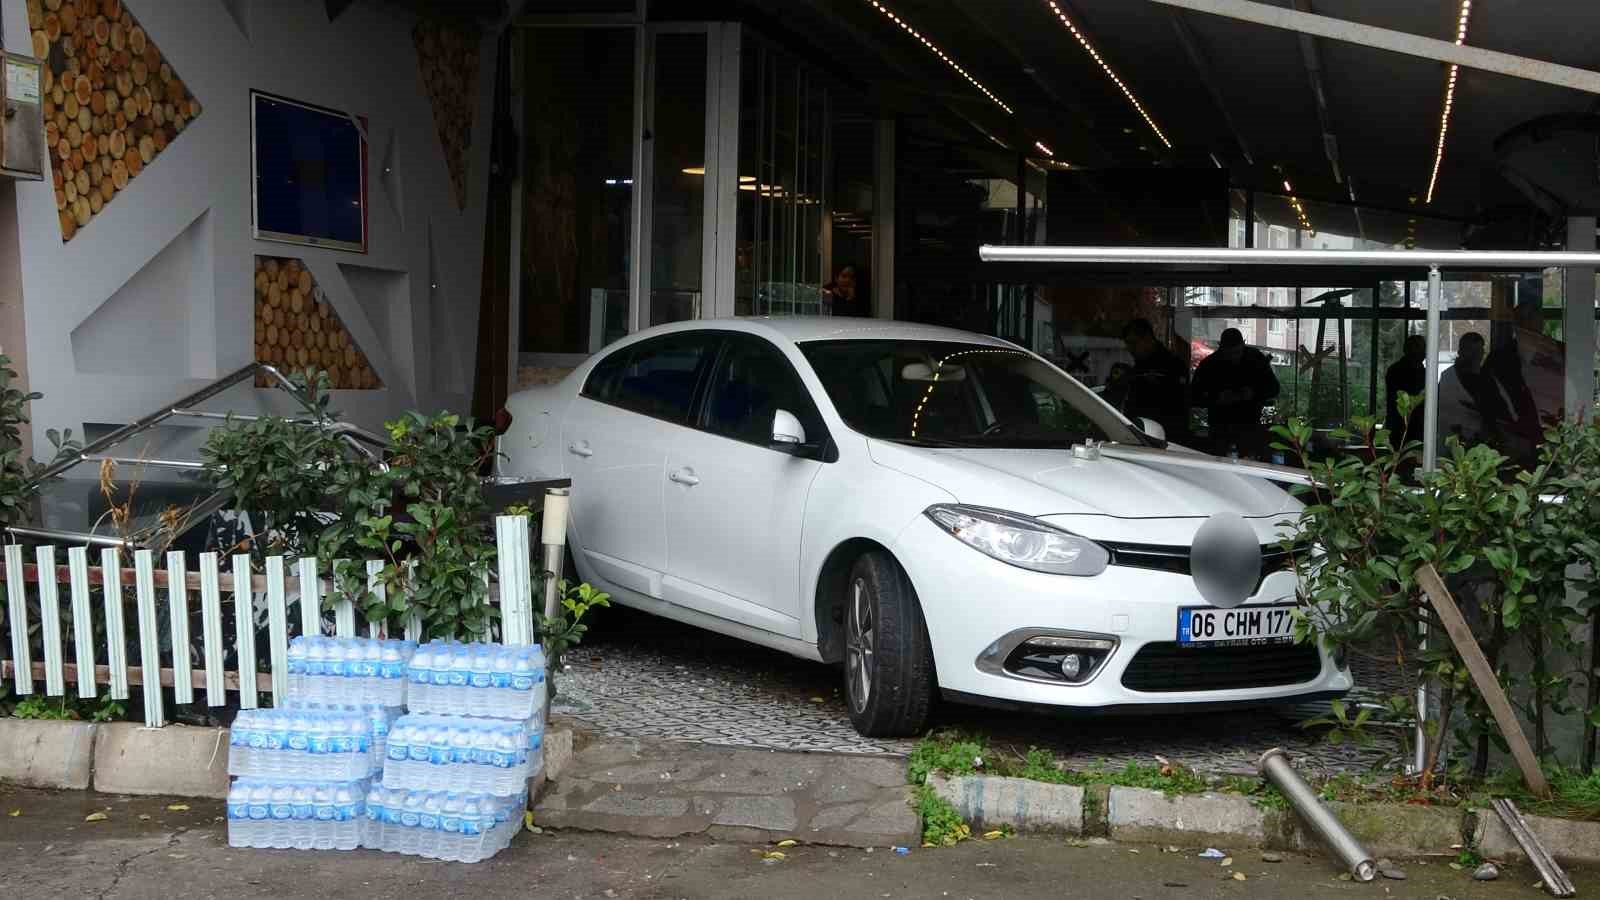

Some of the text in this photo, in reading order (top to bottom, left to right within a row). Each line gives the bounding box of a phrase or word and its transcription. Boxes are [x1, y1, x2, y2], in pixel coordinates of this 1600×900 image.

[1192, 610, 1294, 637] 06 CHM 177
